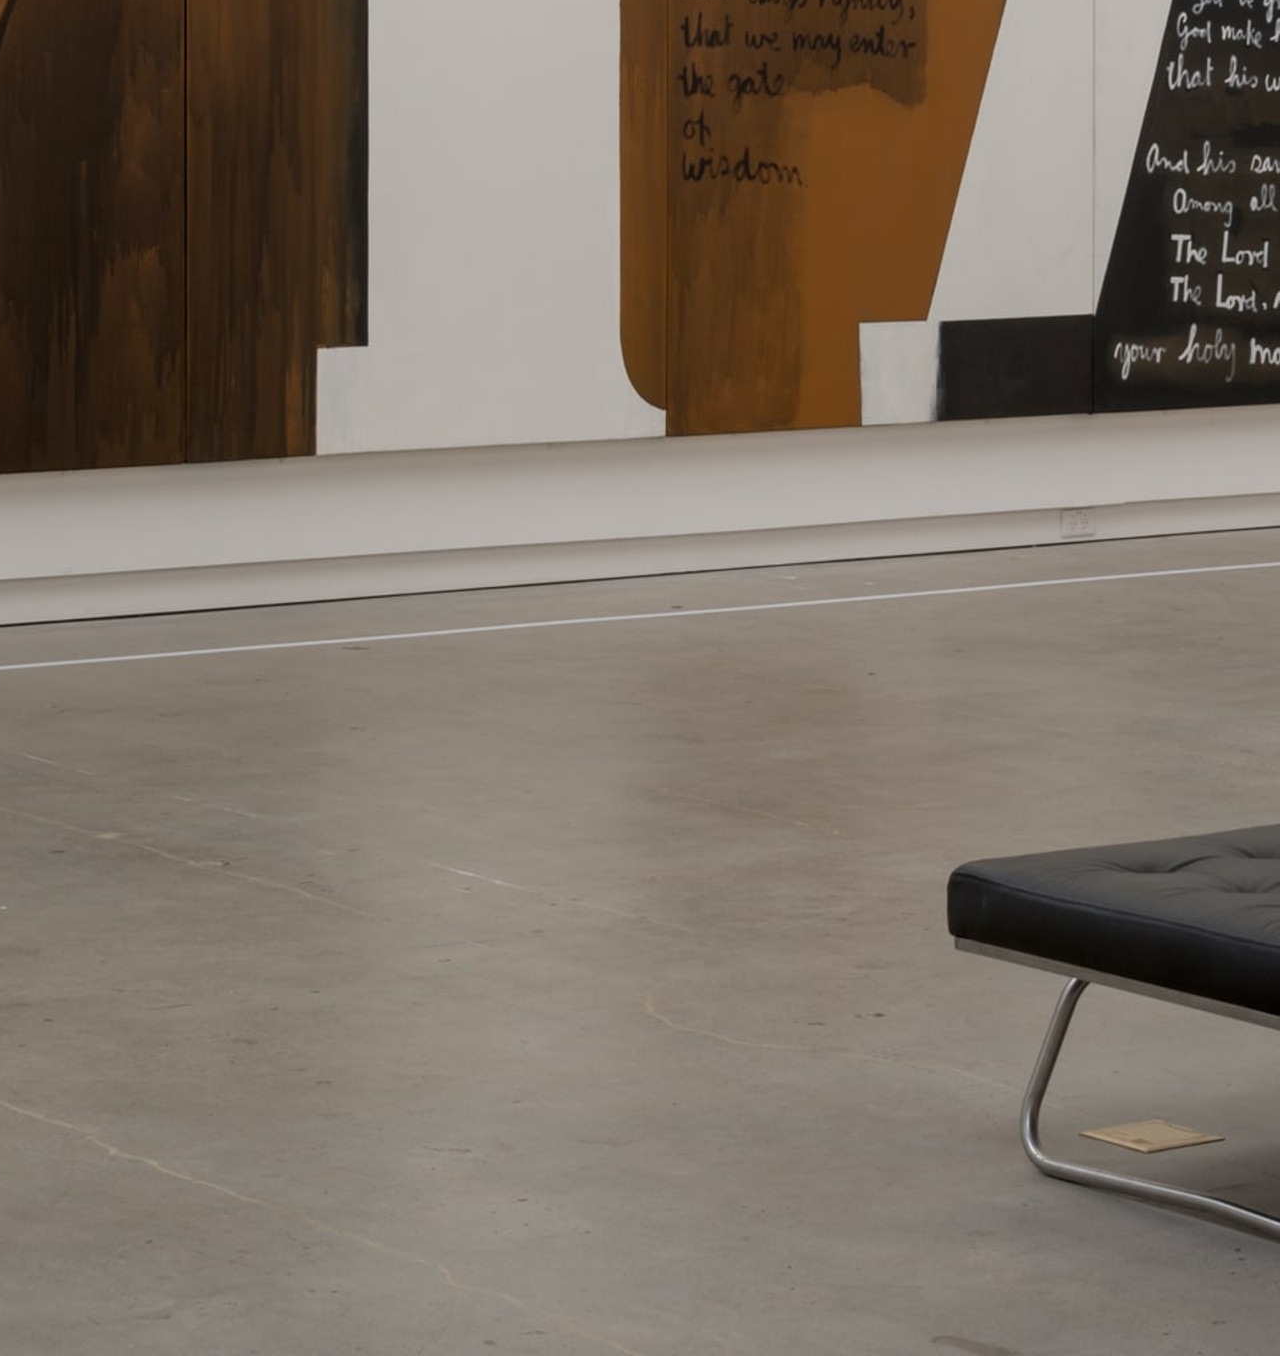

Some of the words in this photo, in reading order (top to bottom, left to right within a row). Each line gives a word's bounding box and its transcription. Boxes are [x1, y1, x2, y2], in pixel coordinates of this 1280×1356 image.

[680, 12, 733, 48] that
[745, 31, 780, 51] we
[792, 32, 842, 69] may
[849, 24, 916, 58] enter
[1176, 11, 1212, 50] God
[1221, 19, 1262, 49] make
[677, 62, 715, 97] the
[728, 62, 786, 108] gate
[1166, 52, 1214, 90] that
[1224, 54, 1258, 89] his
[683, 107, 711, 146] of
[1145, 143, 1190, 175] And
[1196, 139, 1237, 176] his
[1250, 183, 1278, 213] all
[1170, 233, 1208, 265] The
[1221, 230, 1269, 268] Lord
[1169, 274, 1203, 306] The
[1113, 341, 1167, 380] your
[1178, 322, 1237, 383] holy
